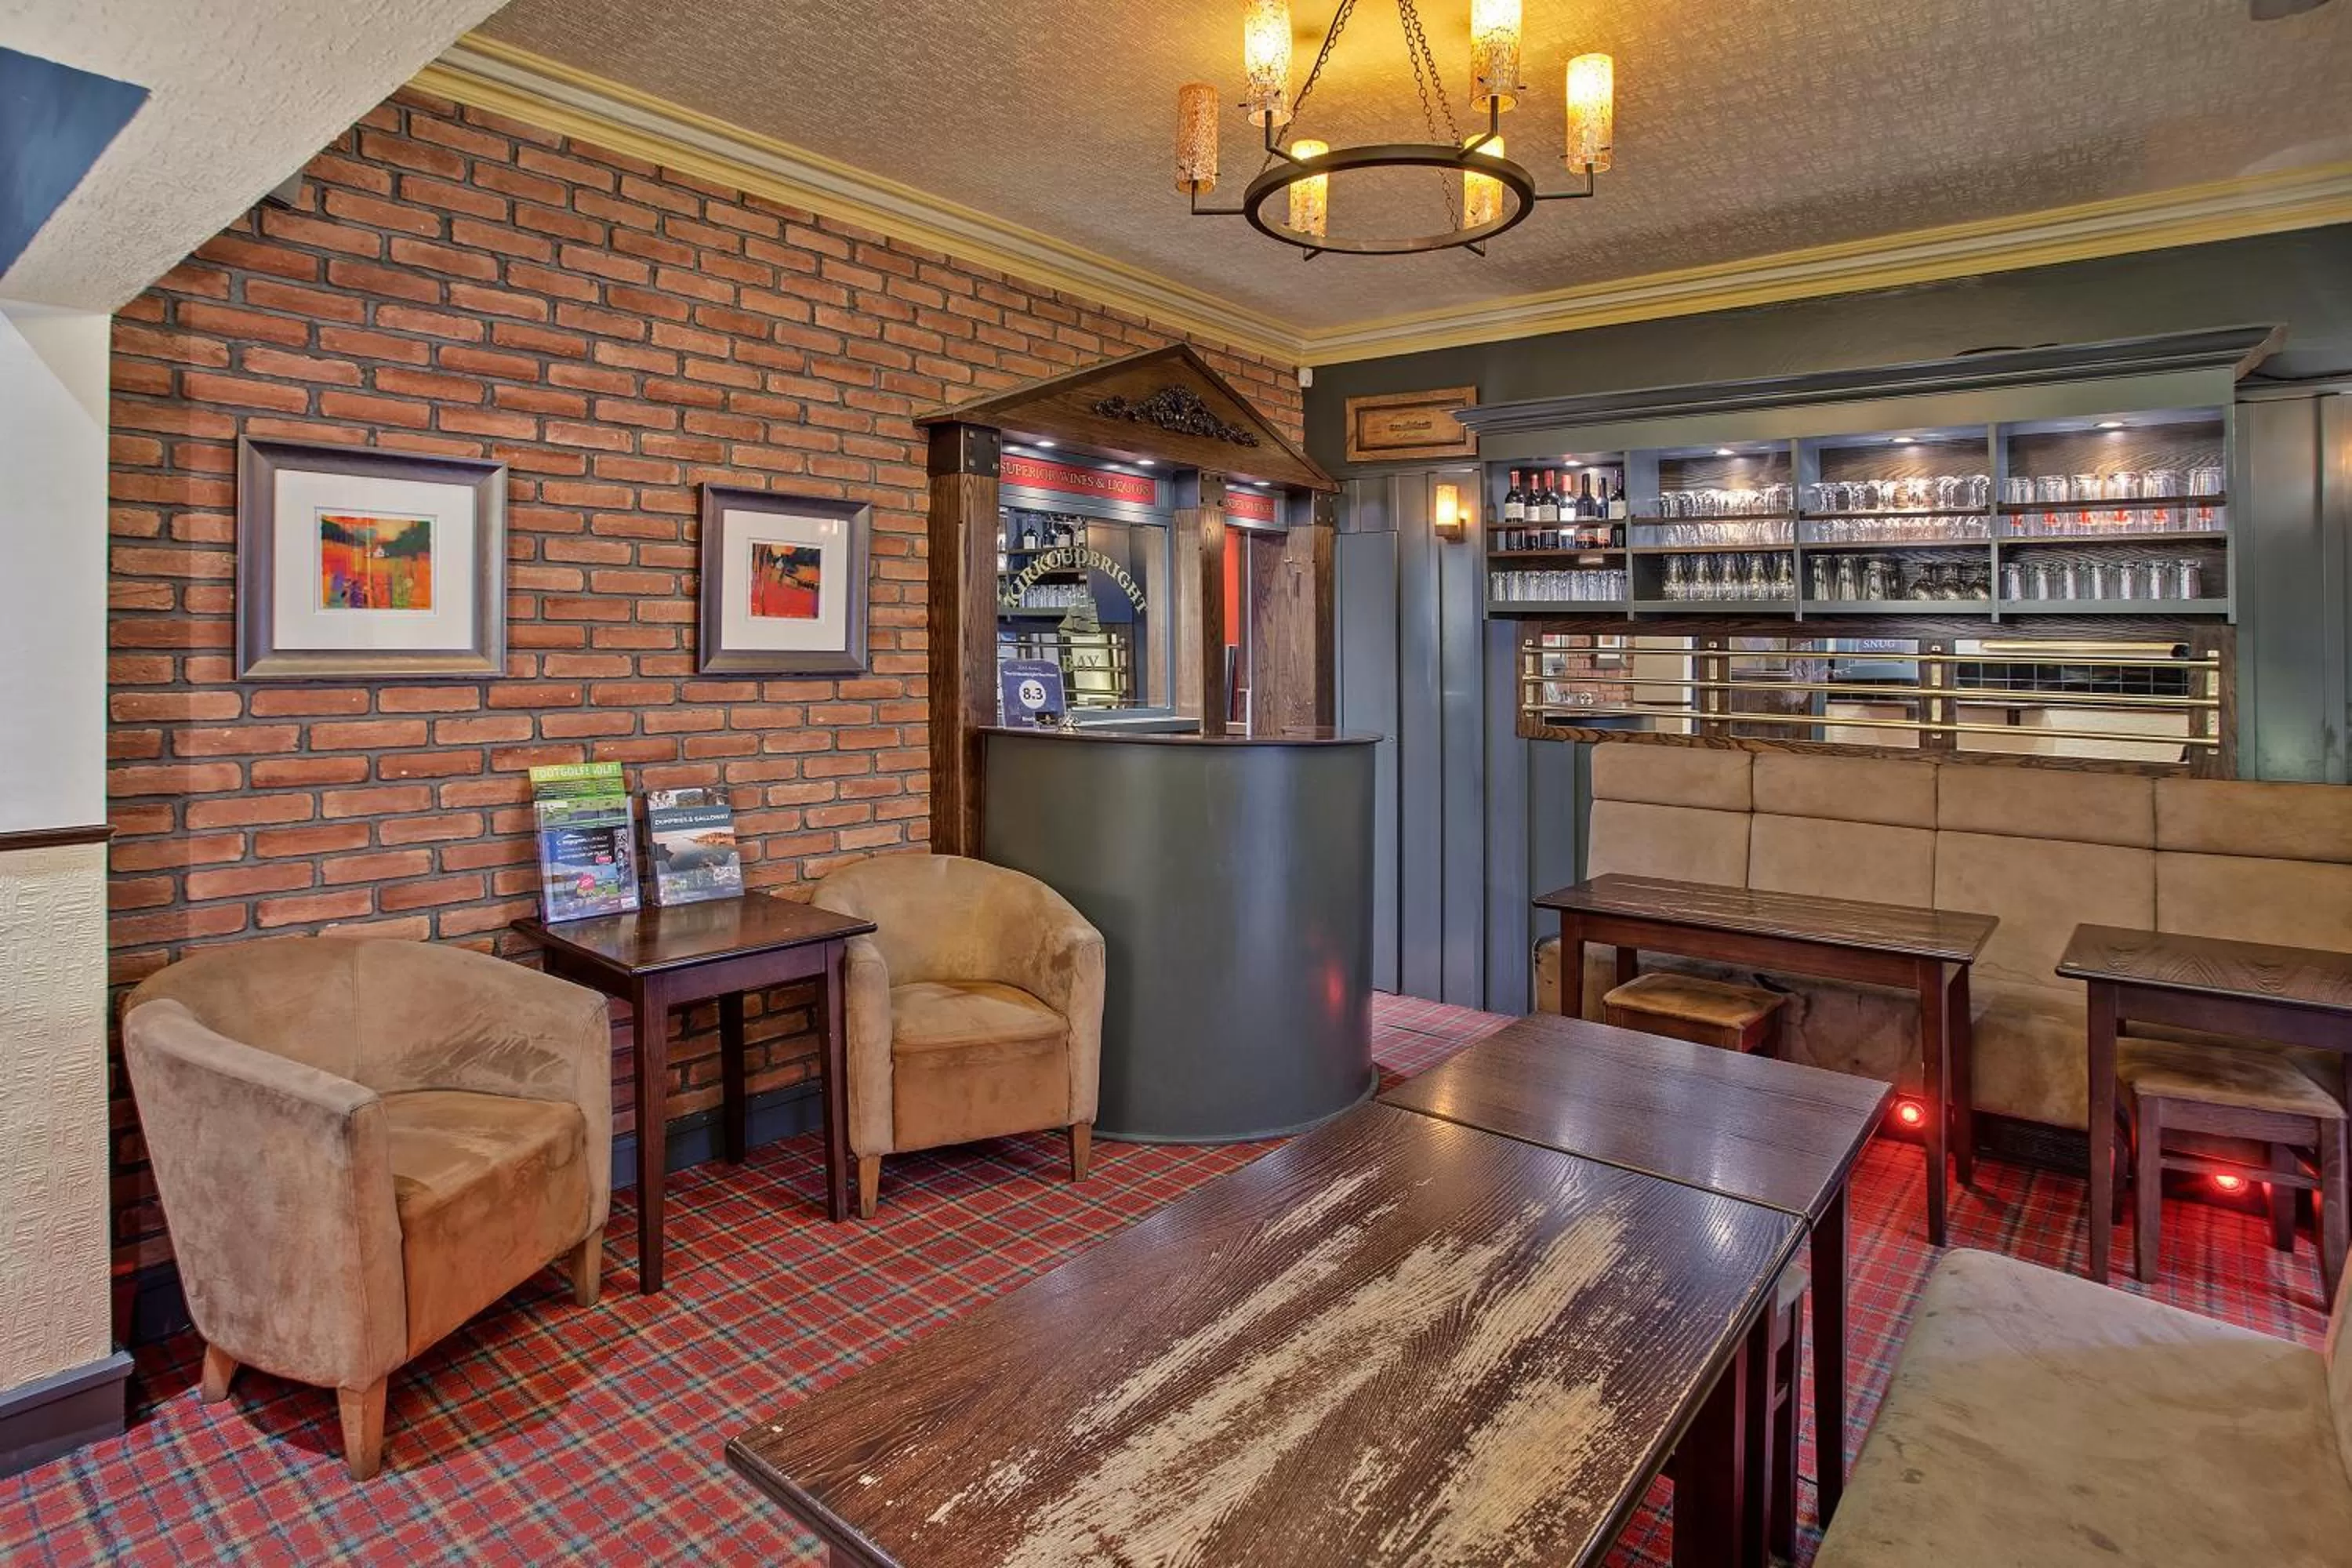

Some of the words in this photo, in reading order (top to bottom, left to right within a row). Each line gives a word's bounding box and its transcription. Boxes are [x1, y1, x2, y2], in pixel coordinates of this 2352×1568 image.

[1000, 462, 1055, 481] SUPERIOR
[1059, 470, 1094, 487] WINES
[1095, 477, 1105, 488] &
[1108, 478, 1149, 495] LIQUORS
[1863, 639, 1895, 648] SNUG
[1062, 655, 1099, 672] BAY
[1023, 688, 1044, 699] 8.3
